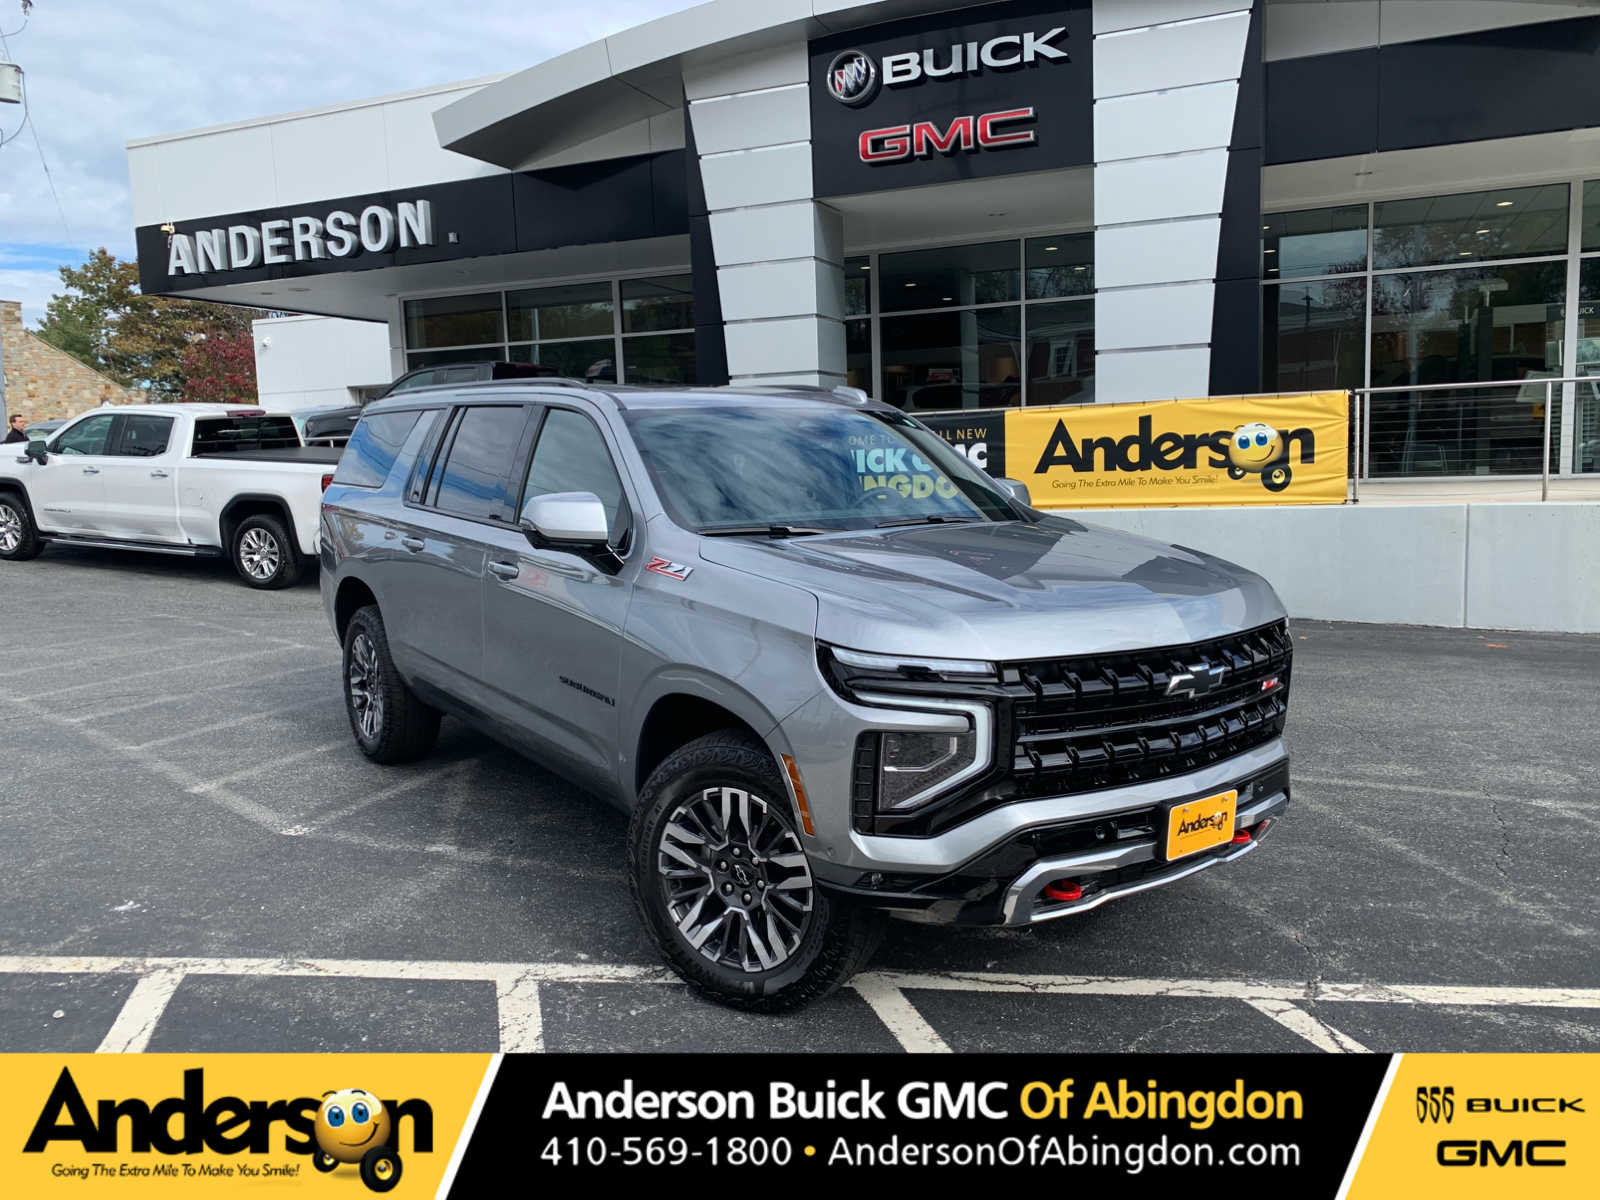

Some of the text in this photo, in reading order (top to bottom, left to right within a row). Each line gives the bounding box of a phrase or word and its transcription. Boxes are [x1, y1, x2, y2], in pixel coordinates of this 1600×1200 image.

[882, 26, 1068, 85] BUICK
[859, 106, 1035, 162] GMC
[168, 199, 433, 276] ANDERSON
[956, 428, 987, 440] NEW
[1034, 414, 1315, 474] Andersn
[850, 448, 909, 473] ICK
[1051, 475, 1218, 490] Going The Extra Mile To Make You Smile!
[1177, 811, 1228, 837] Andersn
